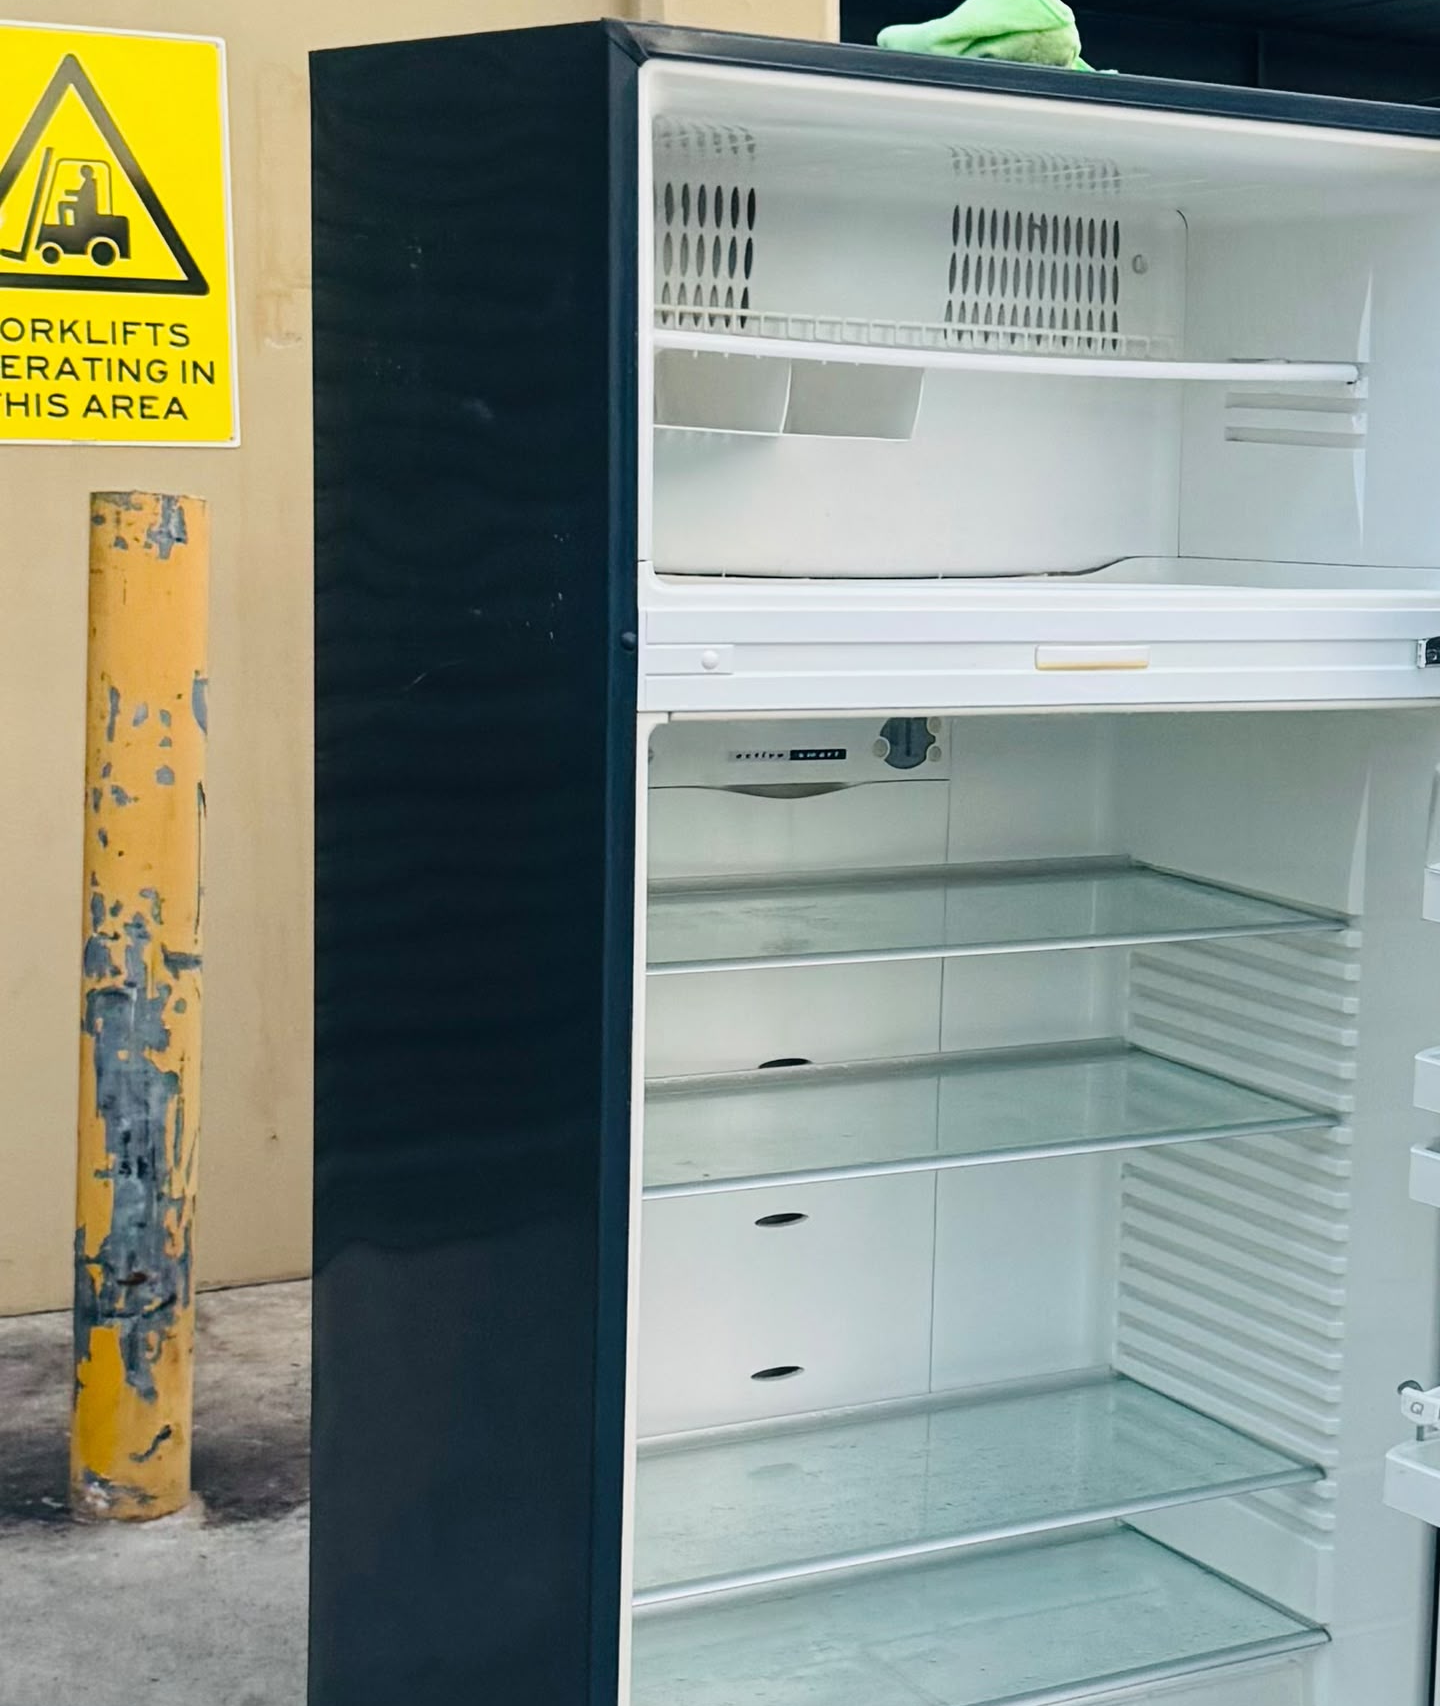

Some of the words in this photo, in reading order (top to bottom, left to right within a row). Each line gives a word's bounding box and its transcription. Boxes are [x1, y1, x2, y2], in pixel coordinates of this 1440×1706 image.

[181, 359, 215, 385] IN
[0, 392, 69, 418] HIS
[82, 394, 189, 421] AREA
